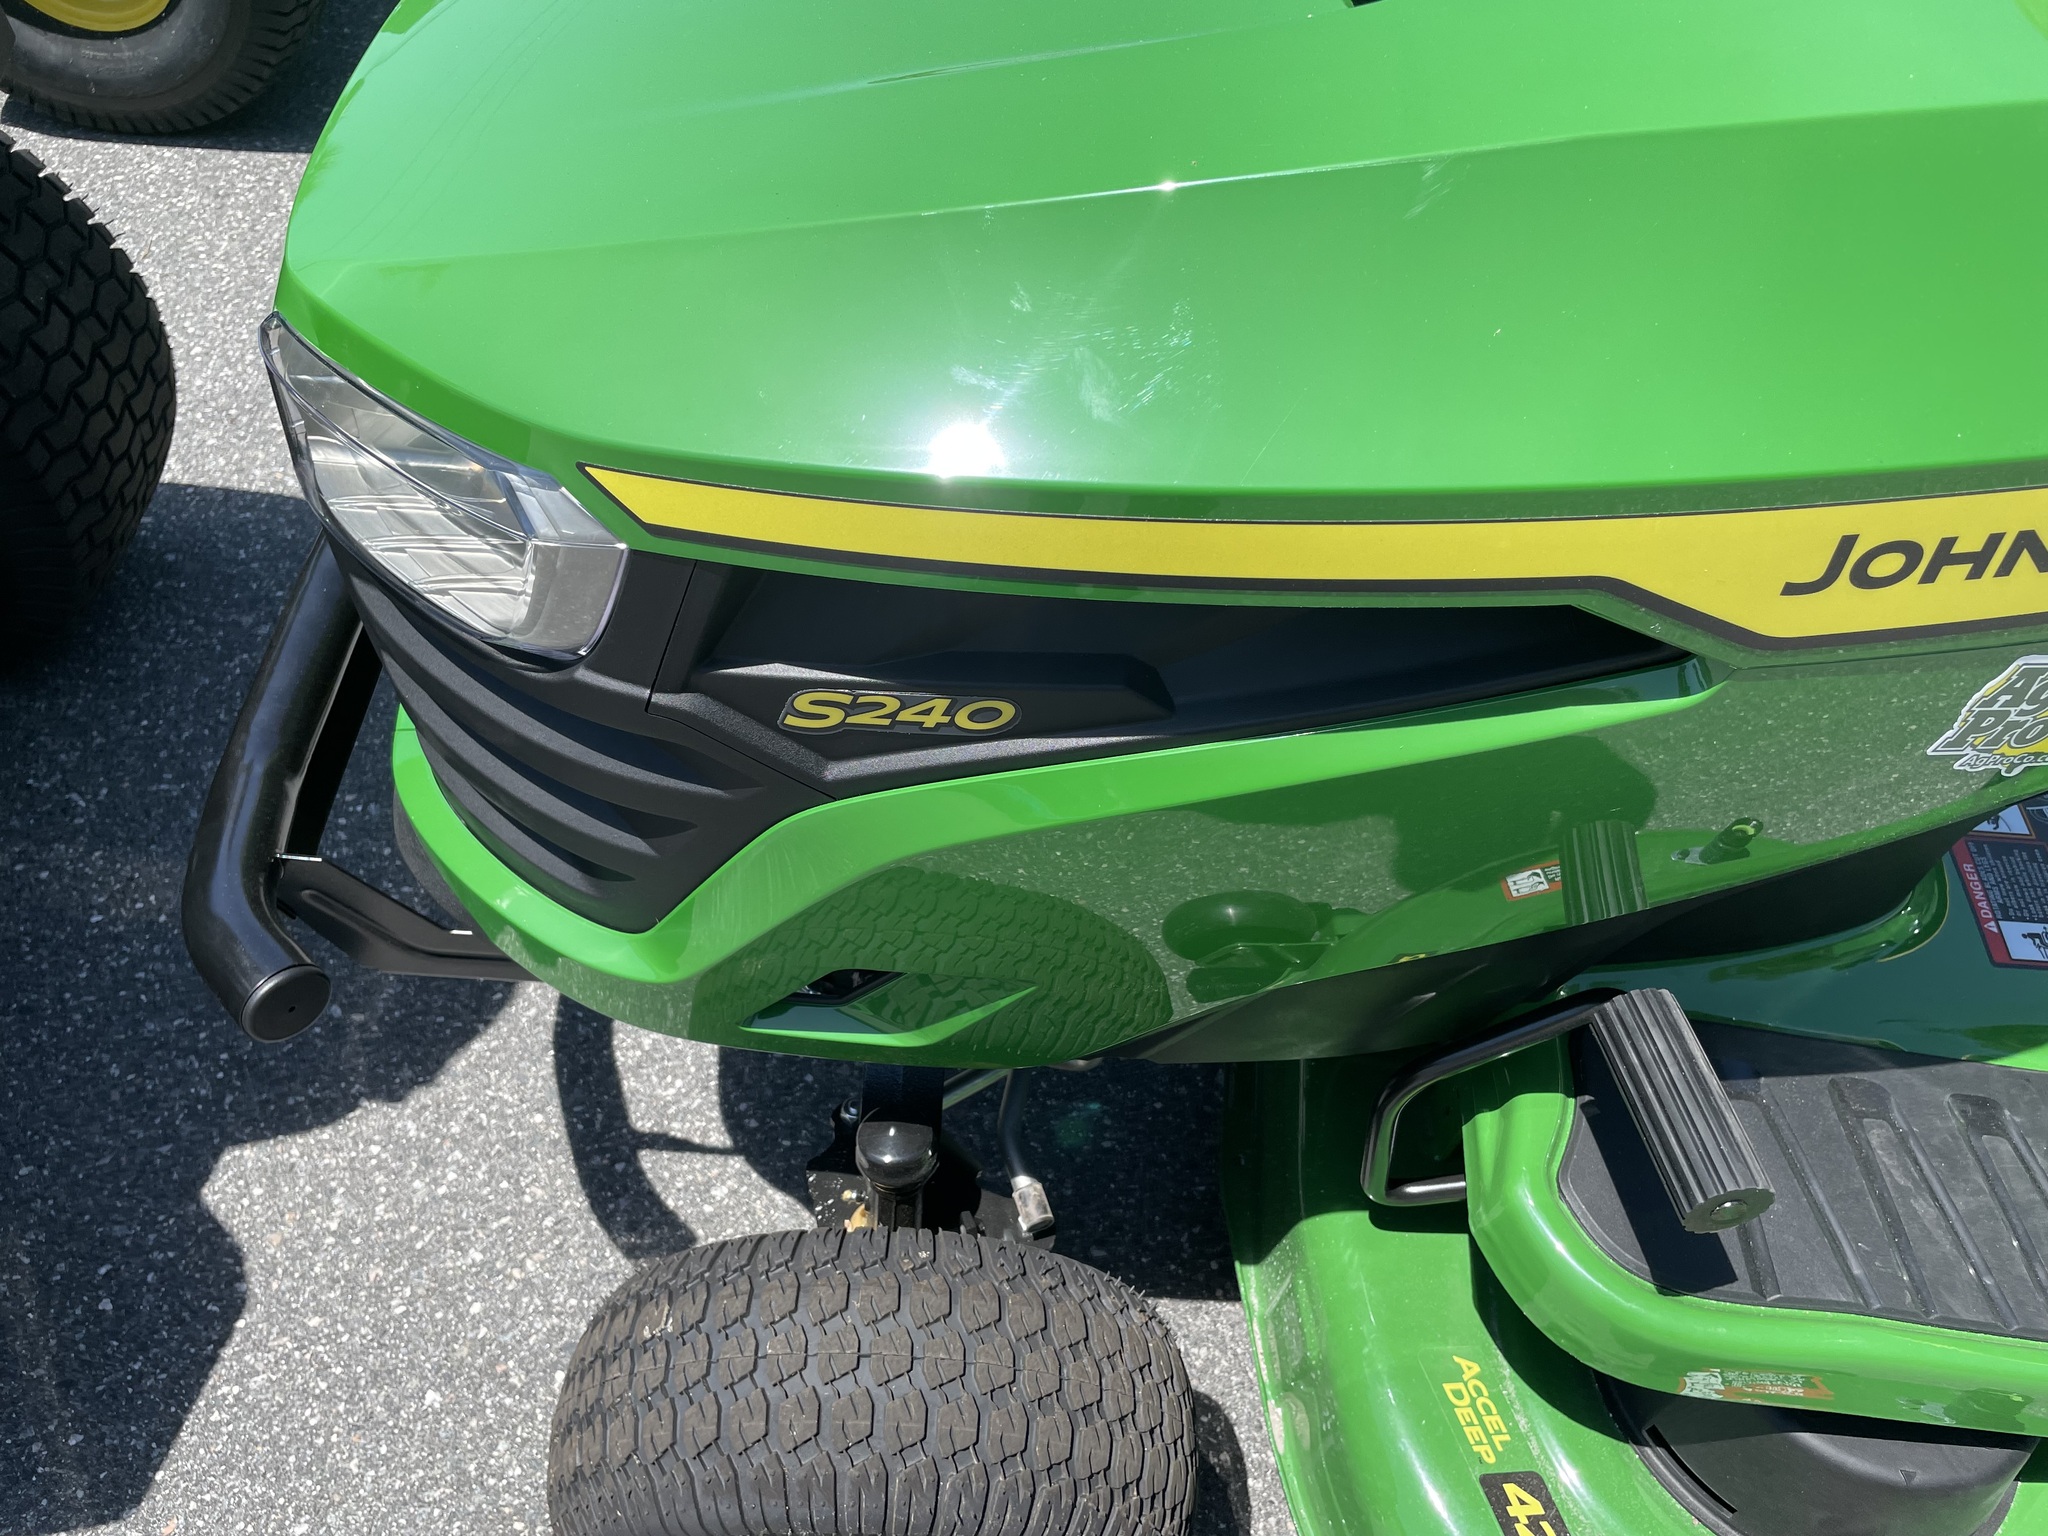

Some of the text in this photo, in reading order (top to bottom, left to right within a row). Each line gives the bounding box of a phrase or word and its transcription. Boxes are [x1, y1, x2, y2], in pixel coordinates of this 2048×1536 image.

[1780, 529, 2048, 596] JOHN
[784, 692, 1017, 730] S240
[1963, 863, 1993, 918] DANGER
[1442, 1382, 1496, 1464] DEEP
[1452, 1355, 1511, 1452] ACCEL
